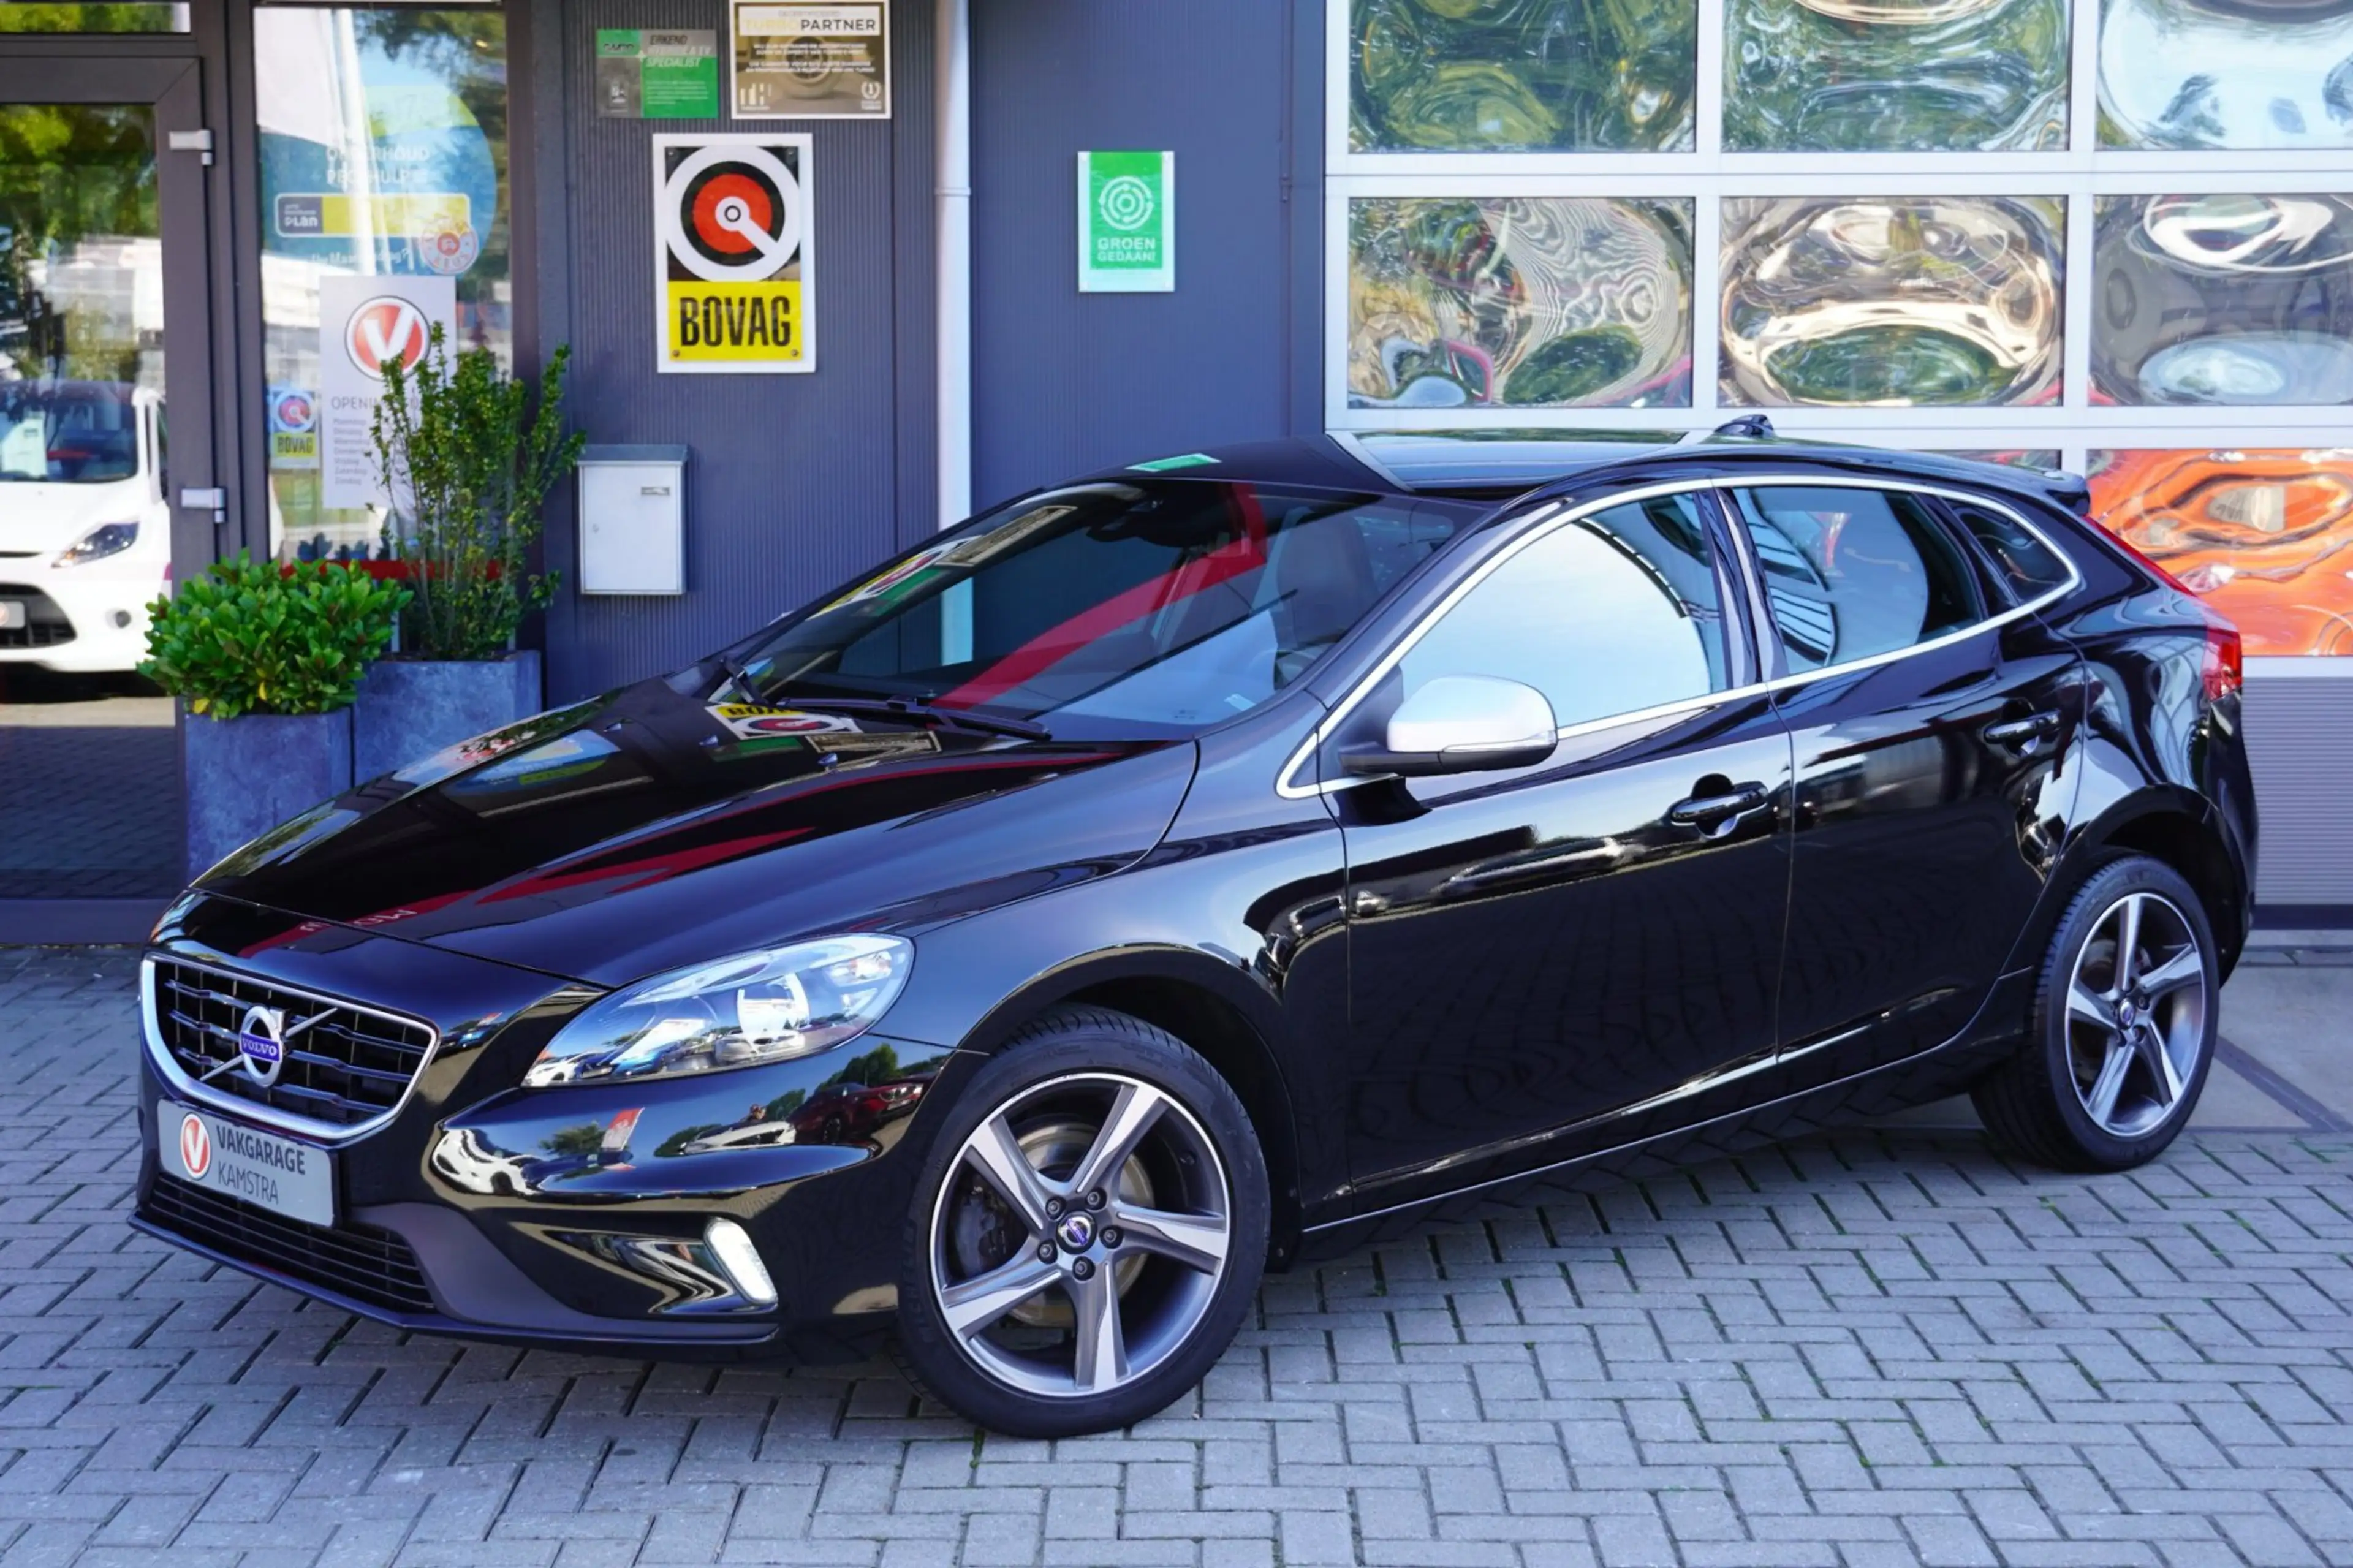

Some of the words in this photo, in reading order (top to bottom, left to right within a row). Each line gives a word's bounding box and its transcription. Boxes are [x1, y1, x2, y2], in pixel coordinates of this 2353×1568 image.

[801, 19, 876, 31] PARTNER
[1098, 237, 1156, 250] GROEN
[680, 295, 791, 347] BOVAG
[278, 436, 313, 453] BOVAG
[243, 1037, 277, 1056] VOLVO
[216, 1124, 306, 1175] VAKGARAGE
[218, 1159, 279, 1205] KAMSTRA
